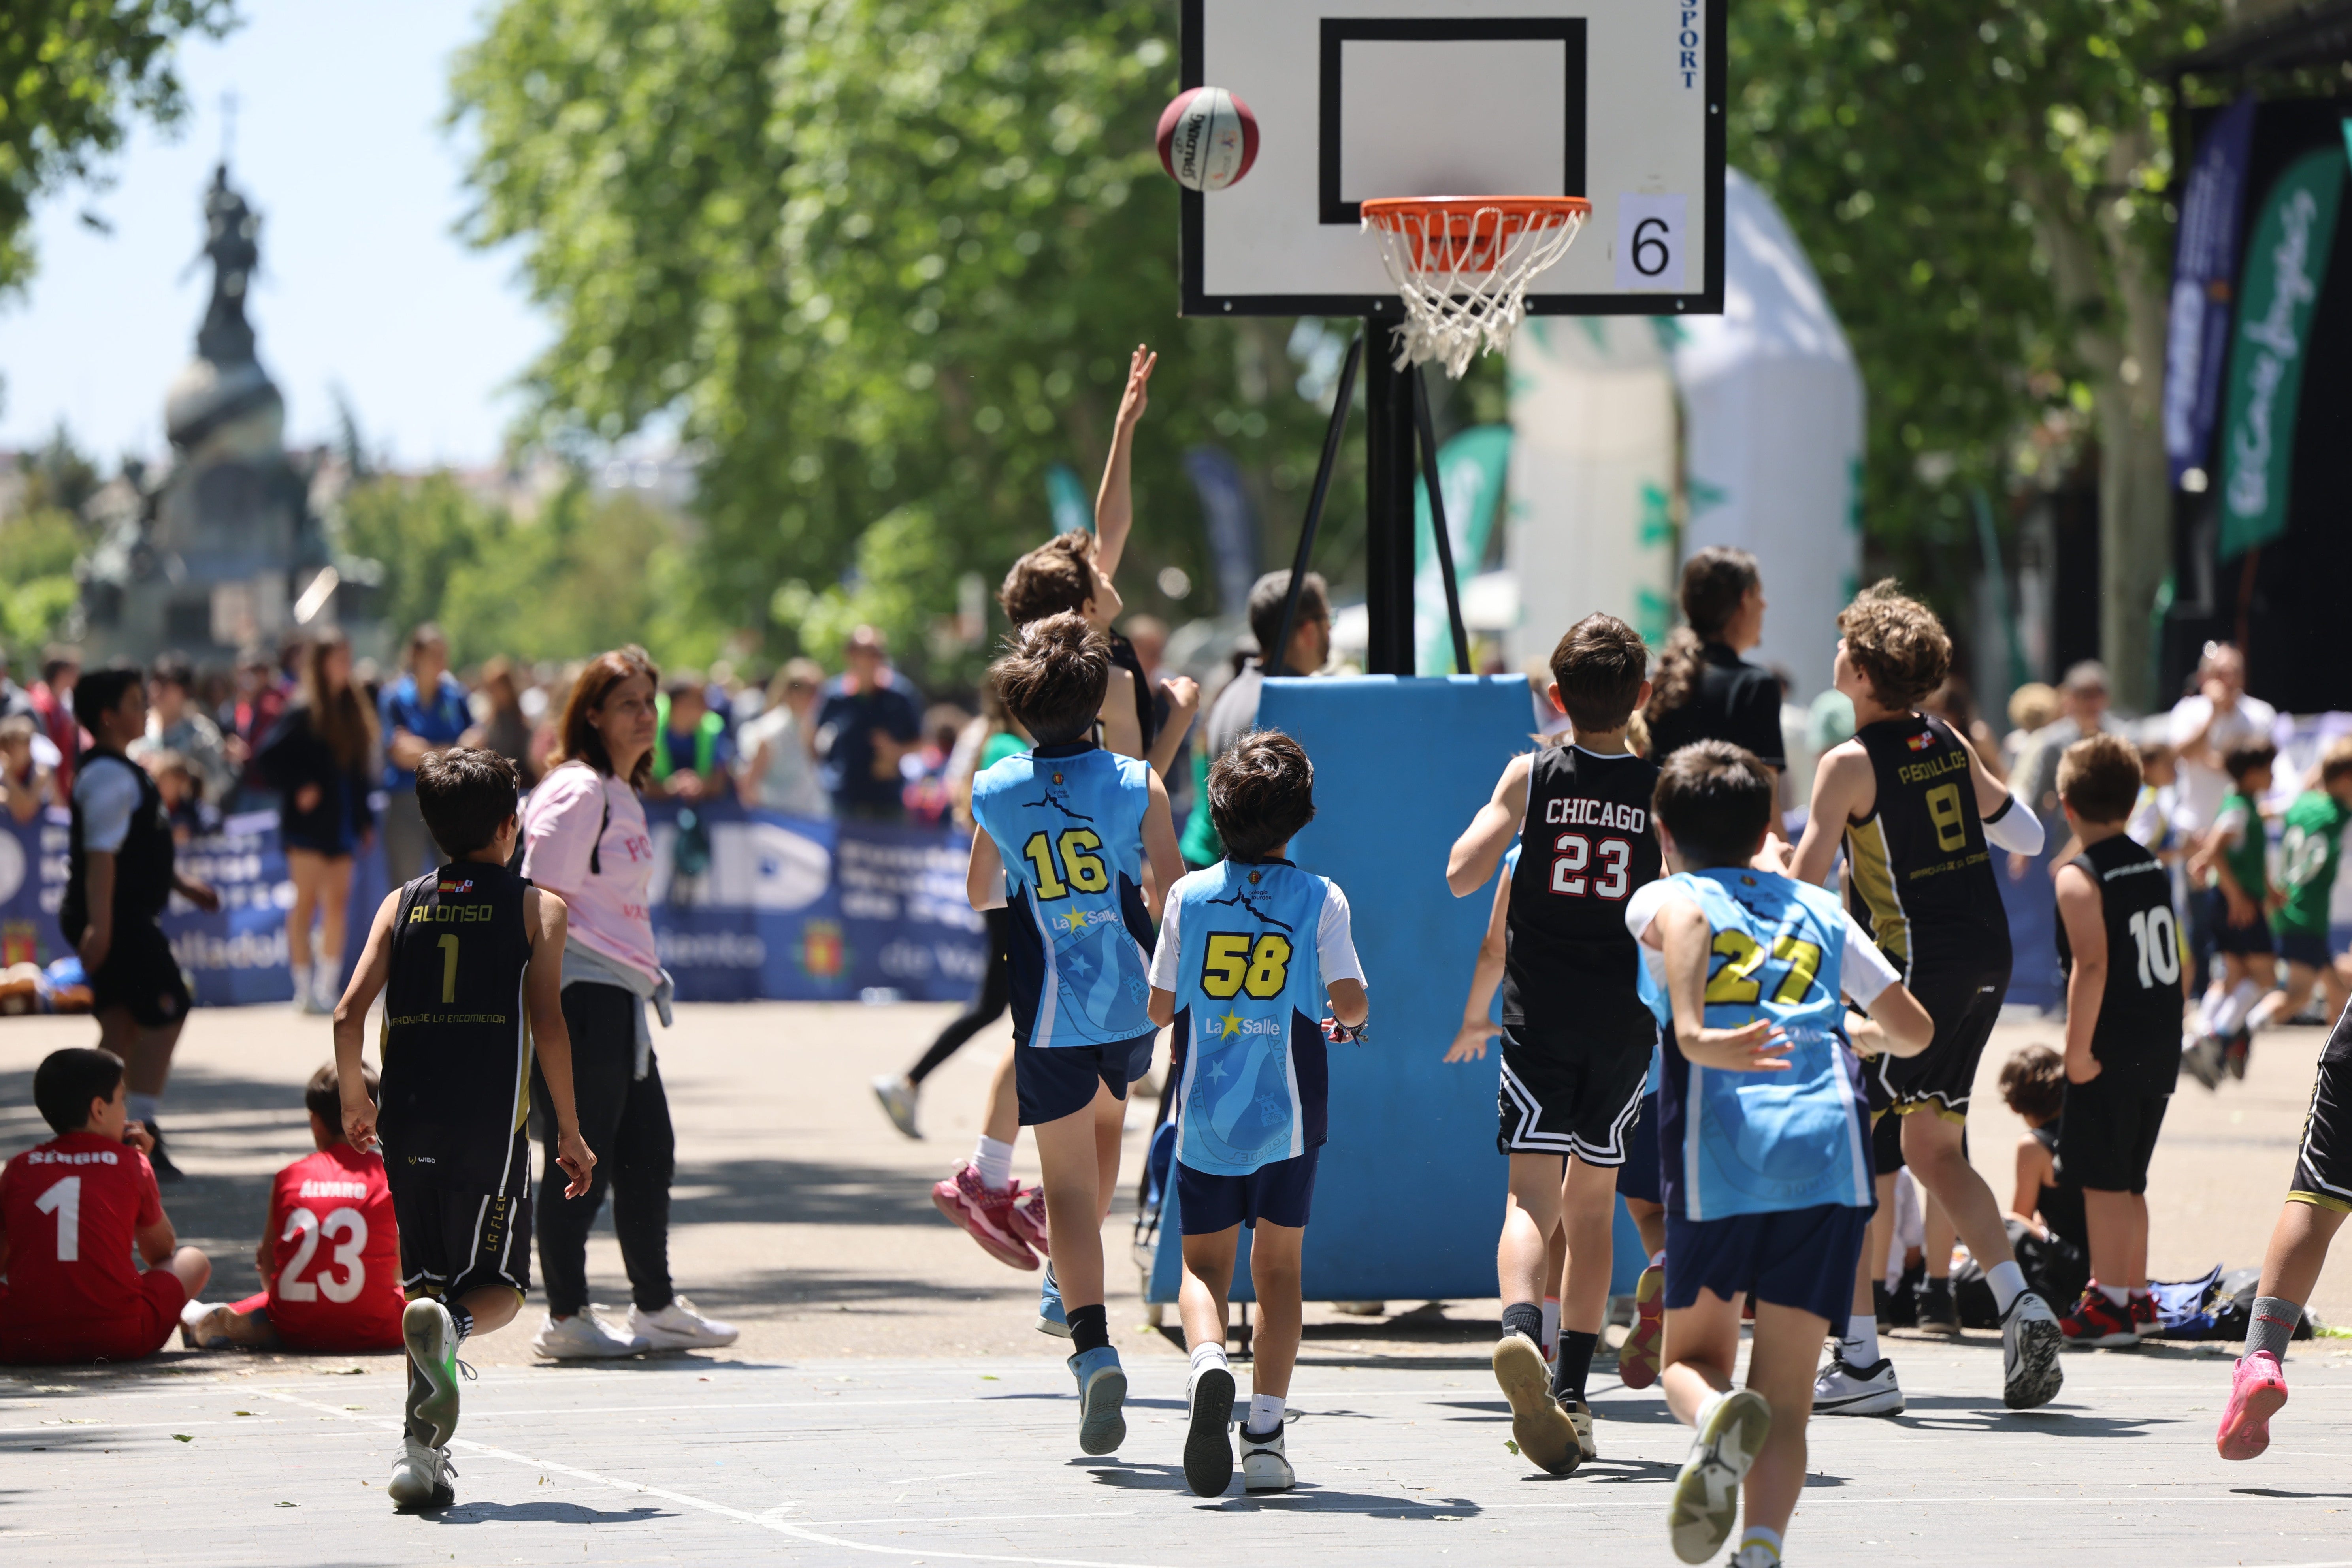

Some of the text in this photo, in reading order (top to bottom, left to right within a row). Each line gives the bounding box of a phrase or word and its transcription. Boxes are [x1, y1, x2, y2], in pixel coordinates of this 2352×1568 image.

[1182, 113, 1205, 181] SPALDING
[1632, 217, 1669, 276] 6
[1545, 798, 1645, 834] CHICAGO
[1925, 783, 1966, 852] 8
[1023, 826, 1110, 902] 16
[1549, 832, 1633, 901] 23
[409, 905, 493, 924] ALONSO
[1052, 910, 1119, 930] La Salle
[1072, 929, 1086, 941] IN
[437, 934, 459, 1003] 1
[1200, 931, 1293, 1000] 58
[1704, 928, 1823, 1007] 27
[2129, 905, 2179, 988] 10
[433, 1015, 445, 1023] LA
[447, 1014, 506, 1024] ENCOMIENDA
[1108, 1020, 1149, 1041] URDES
[1206, 1018, 1280, 1035] La Salle
[1229, 1132, 1289, 1163] LOURDES
[34, 1175, 81, 1262] 1
[485, 1233, 499, 1252] LA
[278, 1207, 369, 1304] 23
